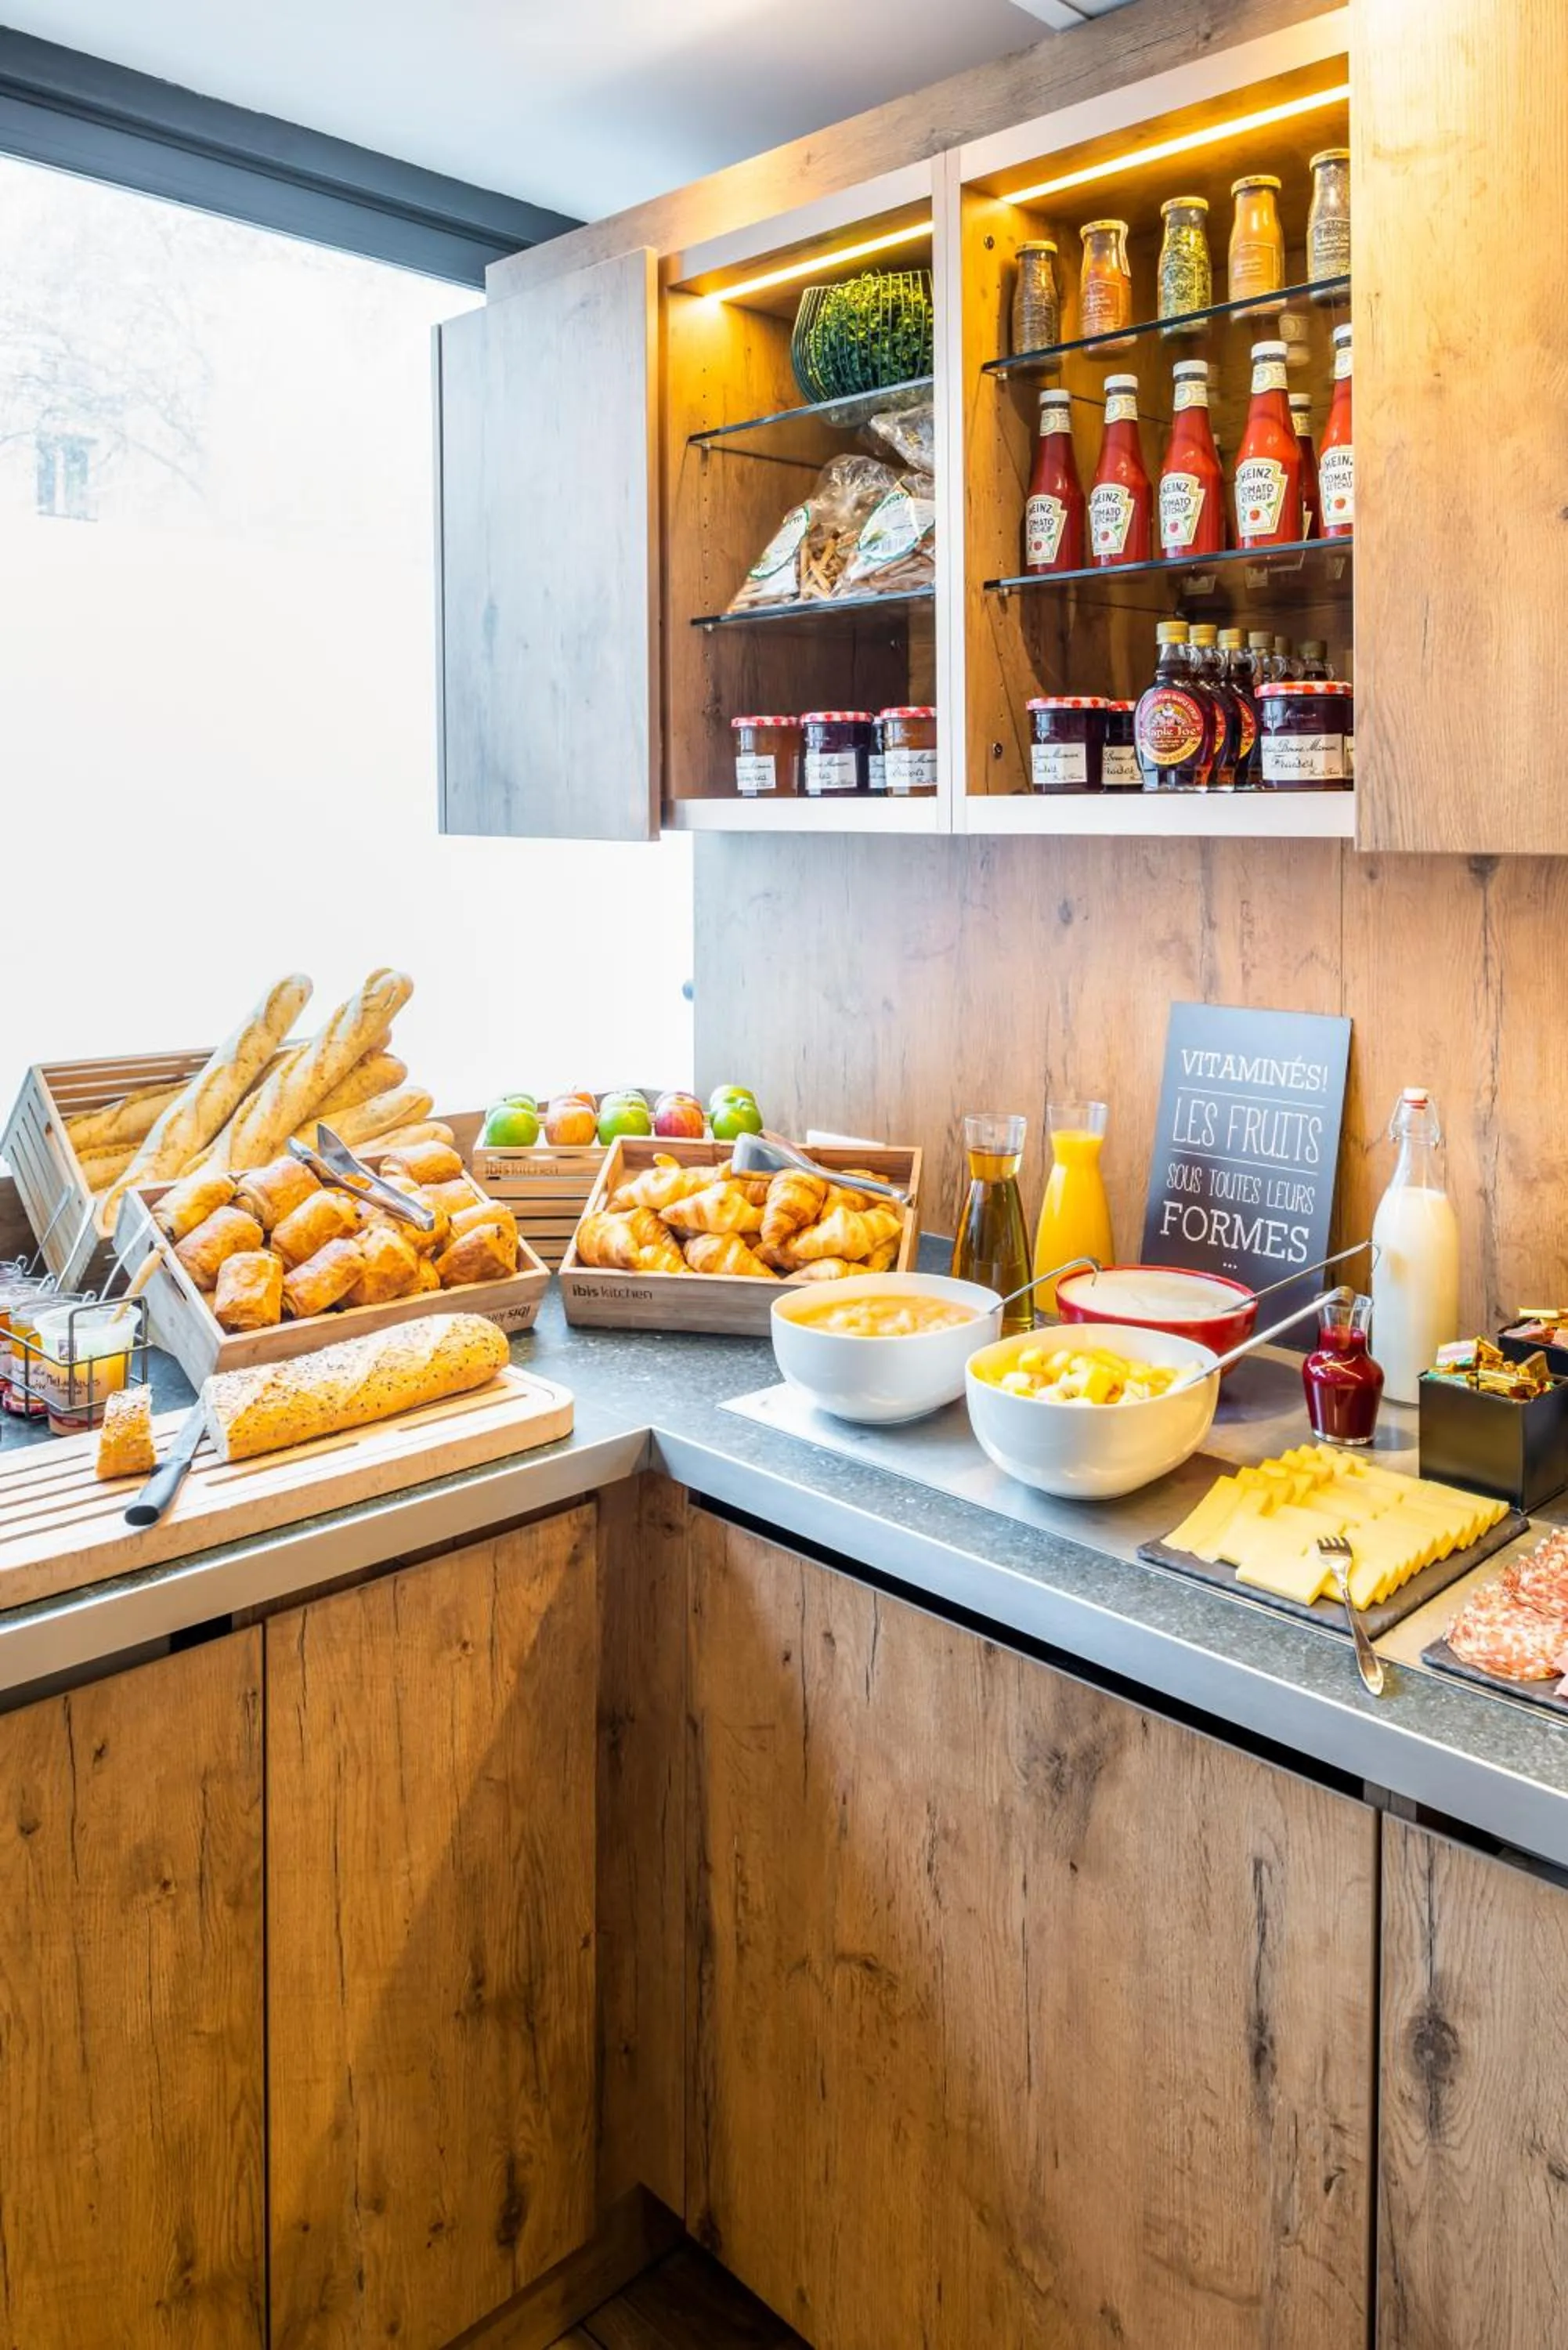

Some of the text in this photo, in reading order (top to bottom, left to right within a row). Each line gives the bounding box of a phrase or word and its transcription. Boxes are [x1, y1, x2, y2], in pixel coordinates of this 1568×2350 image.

[1241, 468, 1272, 483] HEINZ
[1324, 471, 1353, 483] TOMAT
[1162, 479, 1190, 493] HEINZ
[1241, 483, 1274, 496] TOMATO
[1326, 480, 1353, 491] KETCHU
[1181, 1048, 1328, 1093] VITAMINÉS!
[1172, 1097, 1323, 1163] LES FRUITS
[1166, 1163, 1316, 1215] SOUS TOUTES LEURS
[1160, 1200, 1310, 1264] FORMES
[573, 1284, 653, 1300] ibis kitchen
